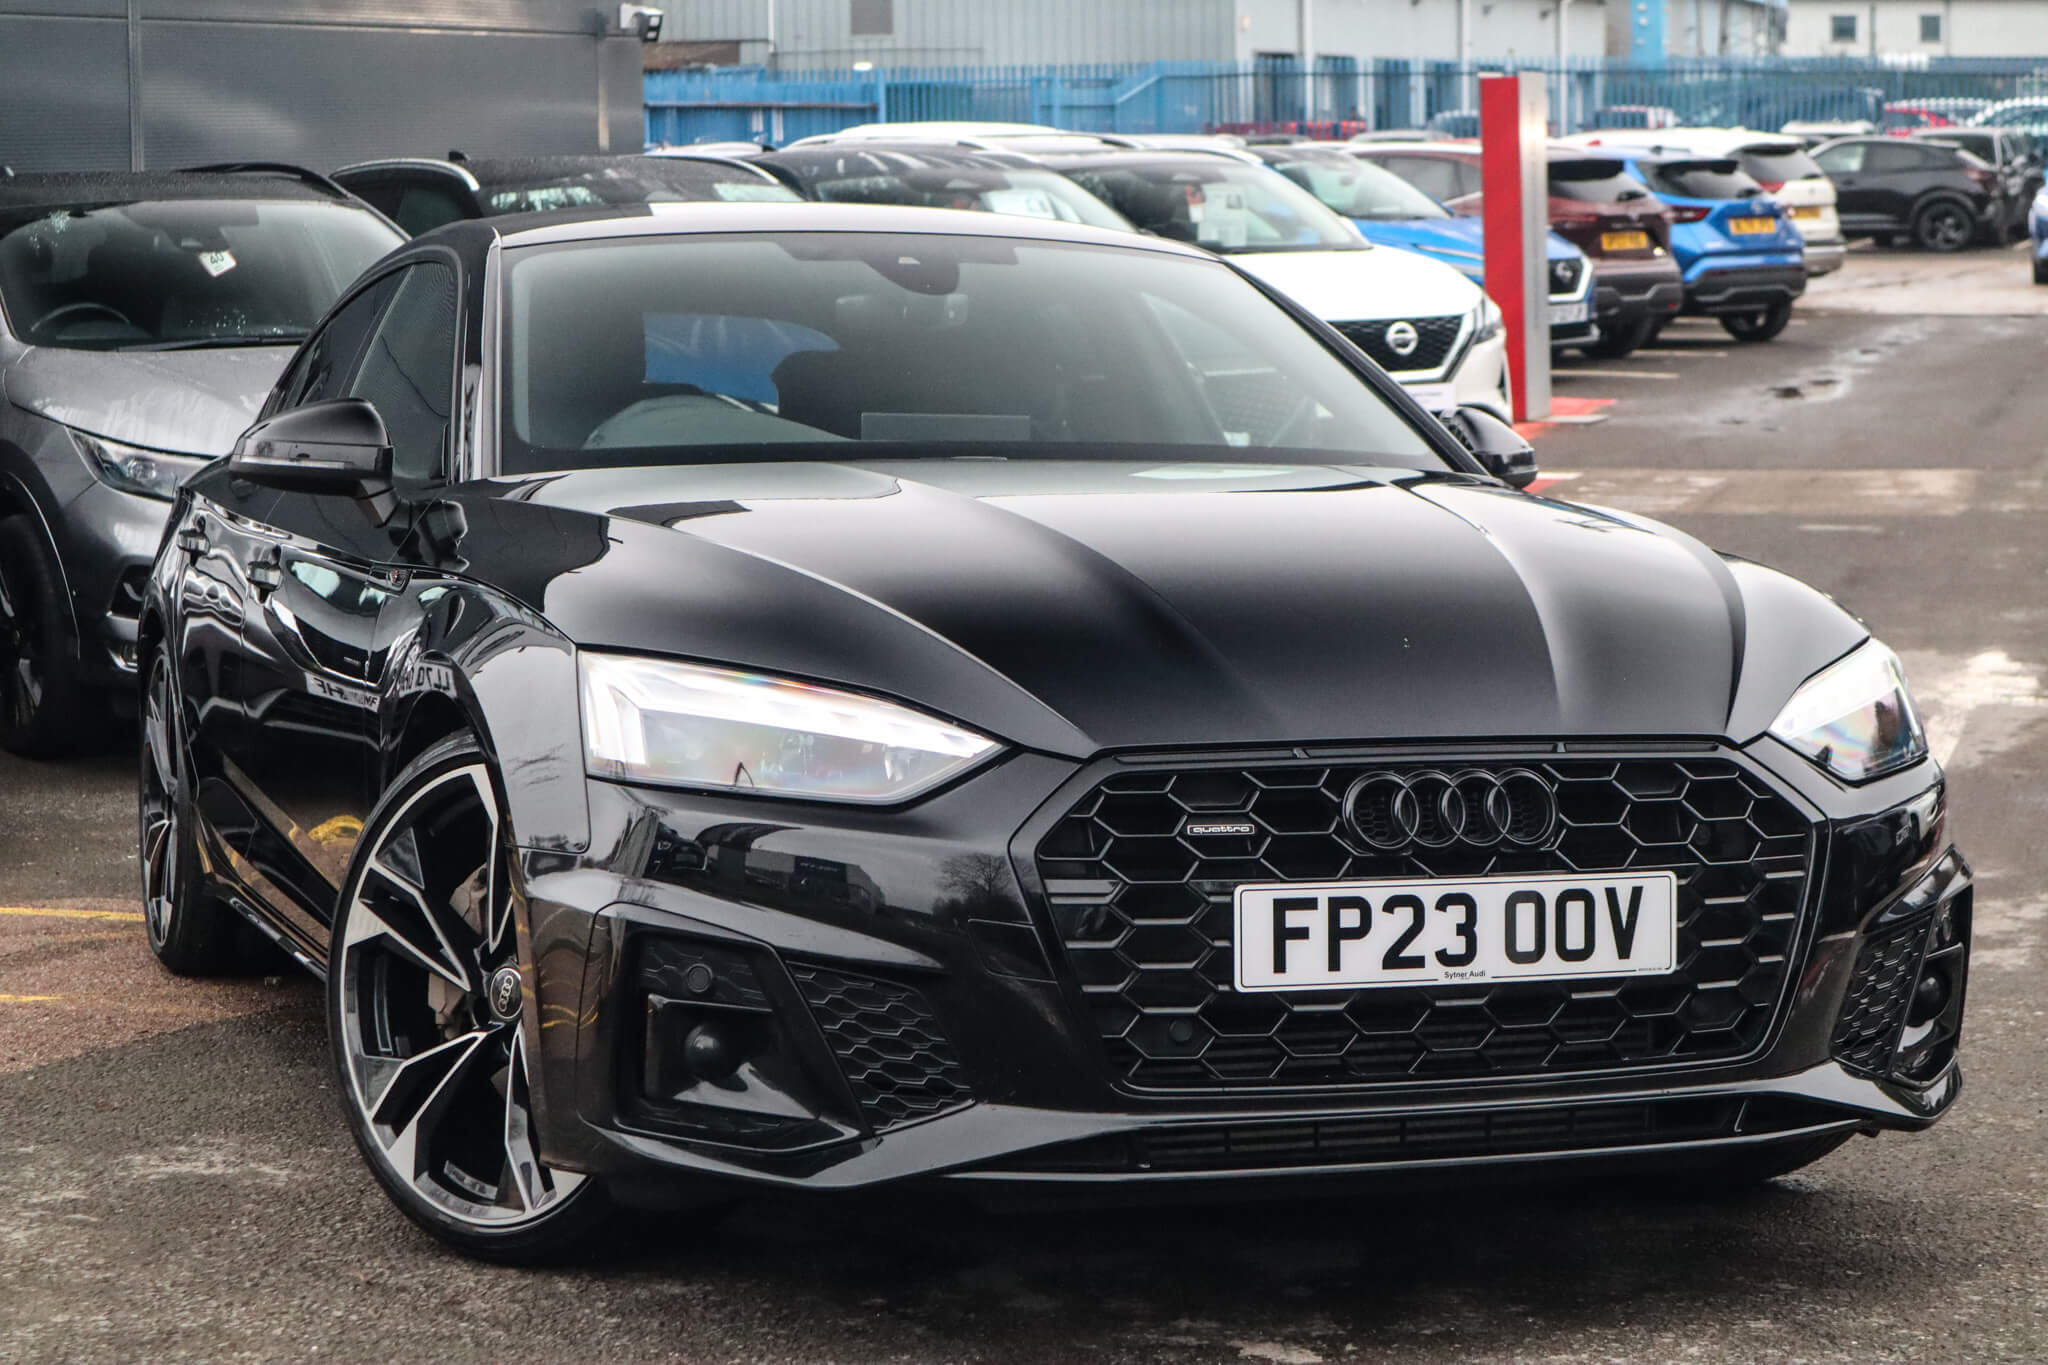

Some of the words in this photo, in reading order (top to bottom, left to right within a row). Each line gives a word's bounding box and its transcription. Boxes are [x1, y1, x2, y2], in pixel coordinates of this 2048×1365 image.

[1192, 825, 1250, 835] quattro
[1272, 892, 1478, 974] FP23
[1504, 886, 1643, 965] OOV
[1444, 971, 1467, 980] Sytner
